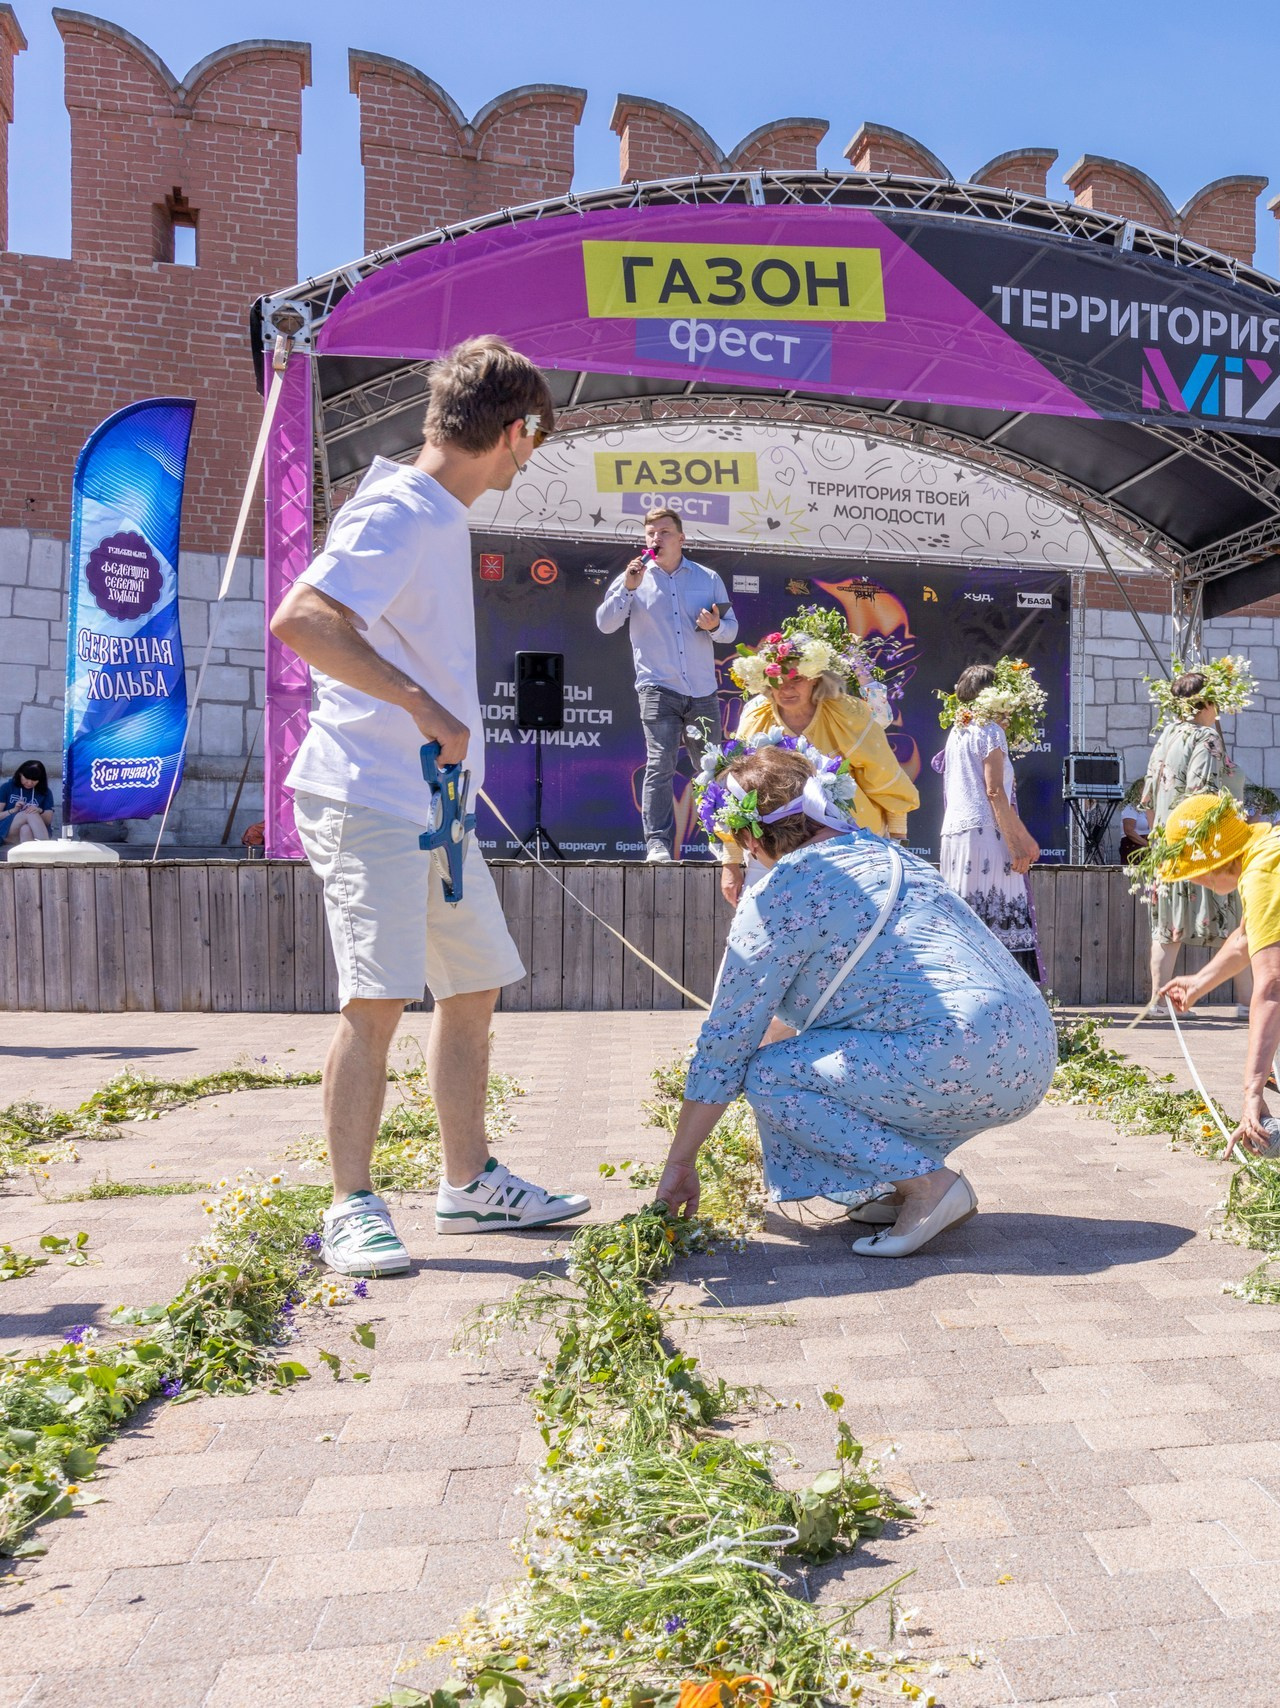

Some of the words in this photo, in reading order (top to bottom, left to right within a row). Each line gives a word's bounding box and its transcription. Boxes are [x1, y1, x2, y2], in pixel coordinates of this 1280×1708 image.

[621, 255, 850, 308] ГАЗОН
[668, 318, 801, 365] фест
[614, 459, 740, 486] ГАЗОН
[807, 481, 911, 502] ТЕРРИТОРИЯ
[916, 490, 970, 507] ТВОЕЙ
[833, 504, 946, 526] МОЛОДОСТИ
[1026, 597, 1052, 606] БАЗА
[78, 628, 175, 667] СЕВЕРНАЯ
[87, 670, 169, 702] ХОДЬБА
[485, 728, 514, 743] НА
[518, 728, 601, 748] УЛИЦАХ
[558, 841, 607, 852] воркаут
